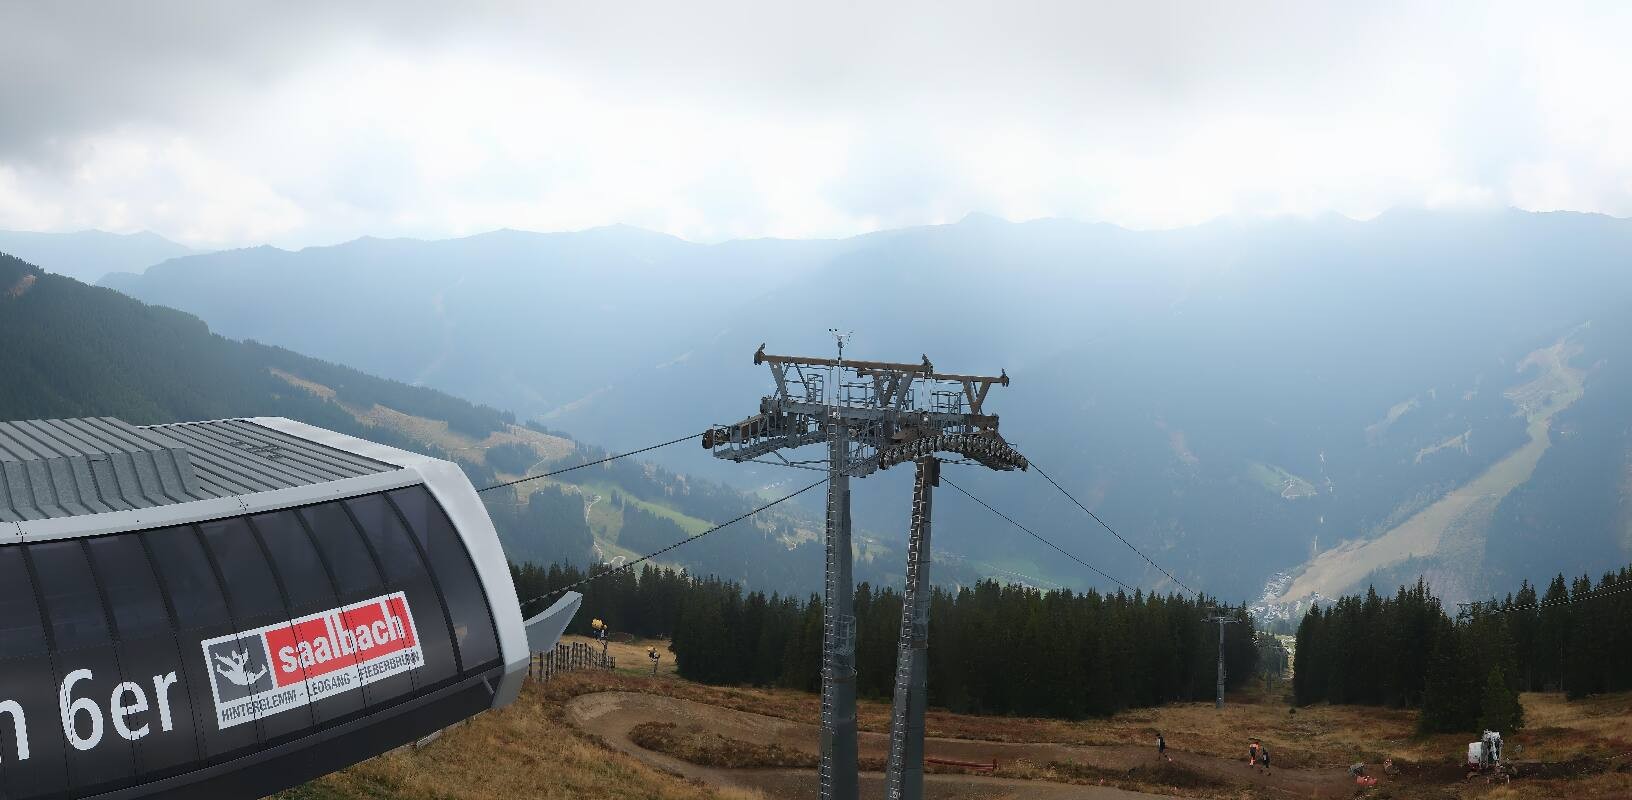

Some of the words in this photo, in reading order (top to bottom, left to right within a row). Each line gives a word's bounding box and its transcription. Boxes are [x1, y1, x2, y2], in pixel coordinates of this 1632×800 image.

[278, 600, 406, 673] saalbach
[59, 668, 178, 751] 6er
[221, 688, 297, 722] HINTERGLEMM
[306, 672, 351, 697] LEOGANG
[358, 650, 420, 684] FIEBERBRUNN
